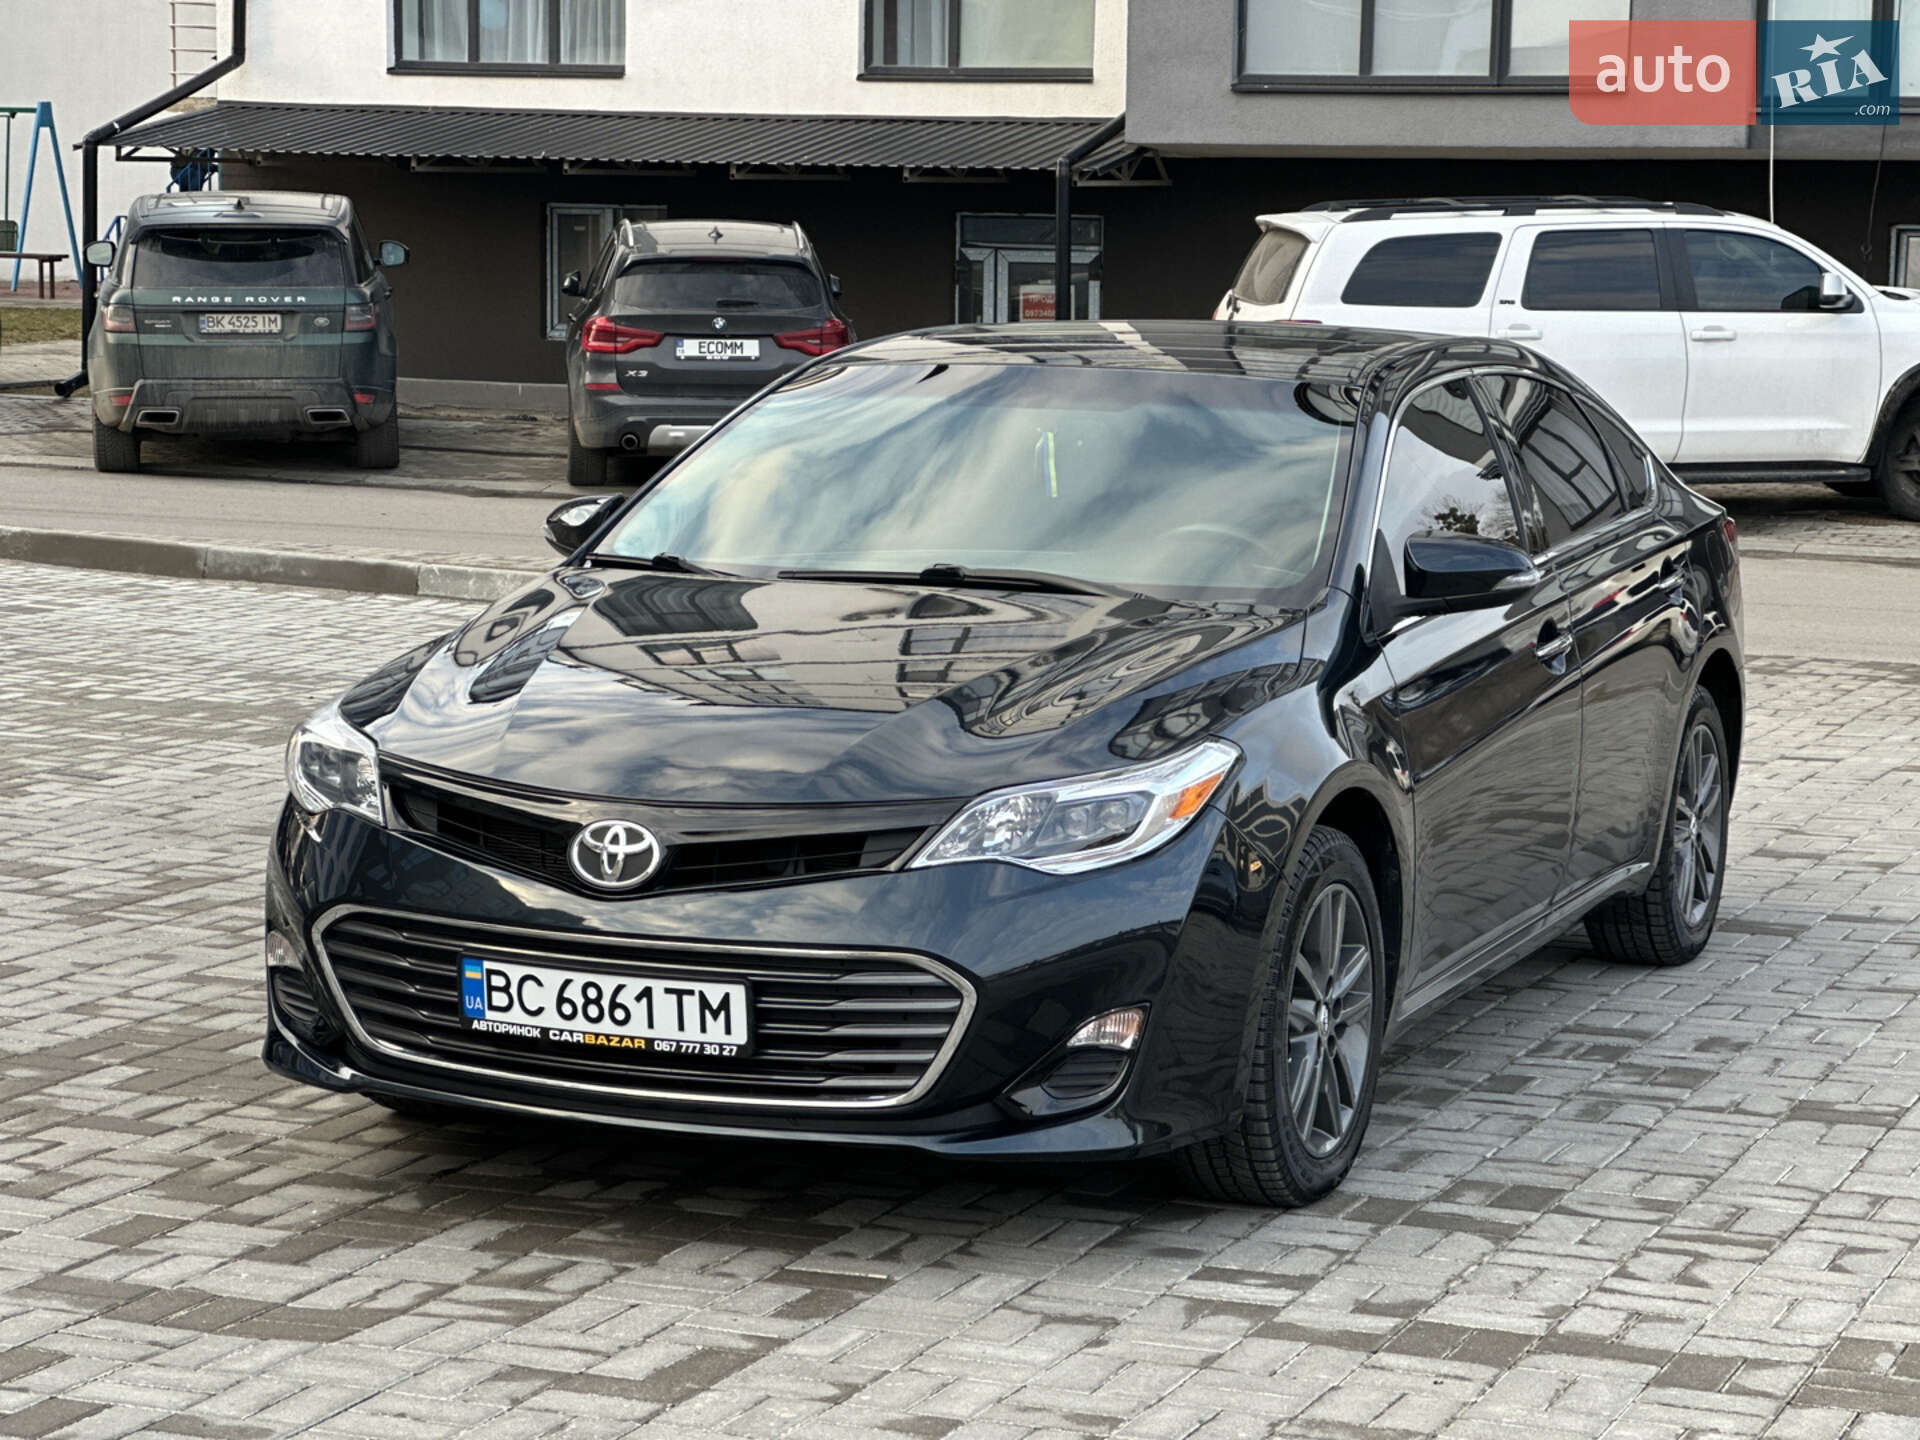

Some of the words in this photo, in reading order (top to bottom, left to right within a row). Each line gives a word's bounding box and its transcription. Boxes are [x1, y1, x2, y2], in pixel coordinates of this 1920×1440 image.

[171, 296, 233, 304] RANGE
[245, 296, 307, 304] ROVER
[206, 315, 226, 329] BK
[228, 315, 257, 329] 4525
[262, 315, 279, 329] IM
[698, 341, 744, 354] ECOMM
[465, 995, 483, 1010] UA
[485, 968, 545, 1017] BC
[556, 978, 654, 1030] 6861
[663, 987, 732, 1036] TM
[472, 1019, 541, 1038] АВТОРИНОК
[548, 1029, 646, 1049] CARBAZAR
[654, 1040, 677, 1053] 067
[679, 1042, 701, 1054] 777
[703, 1044, 720, 1055] 30
[722, 1045, 738, 1057] 27
